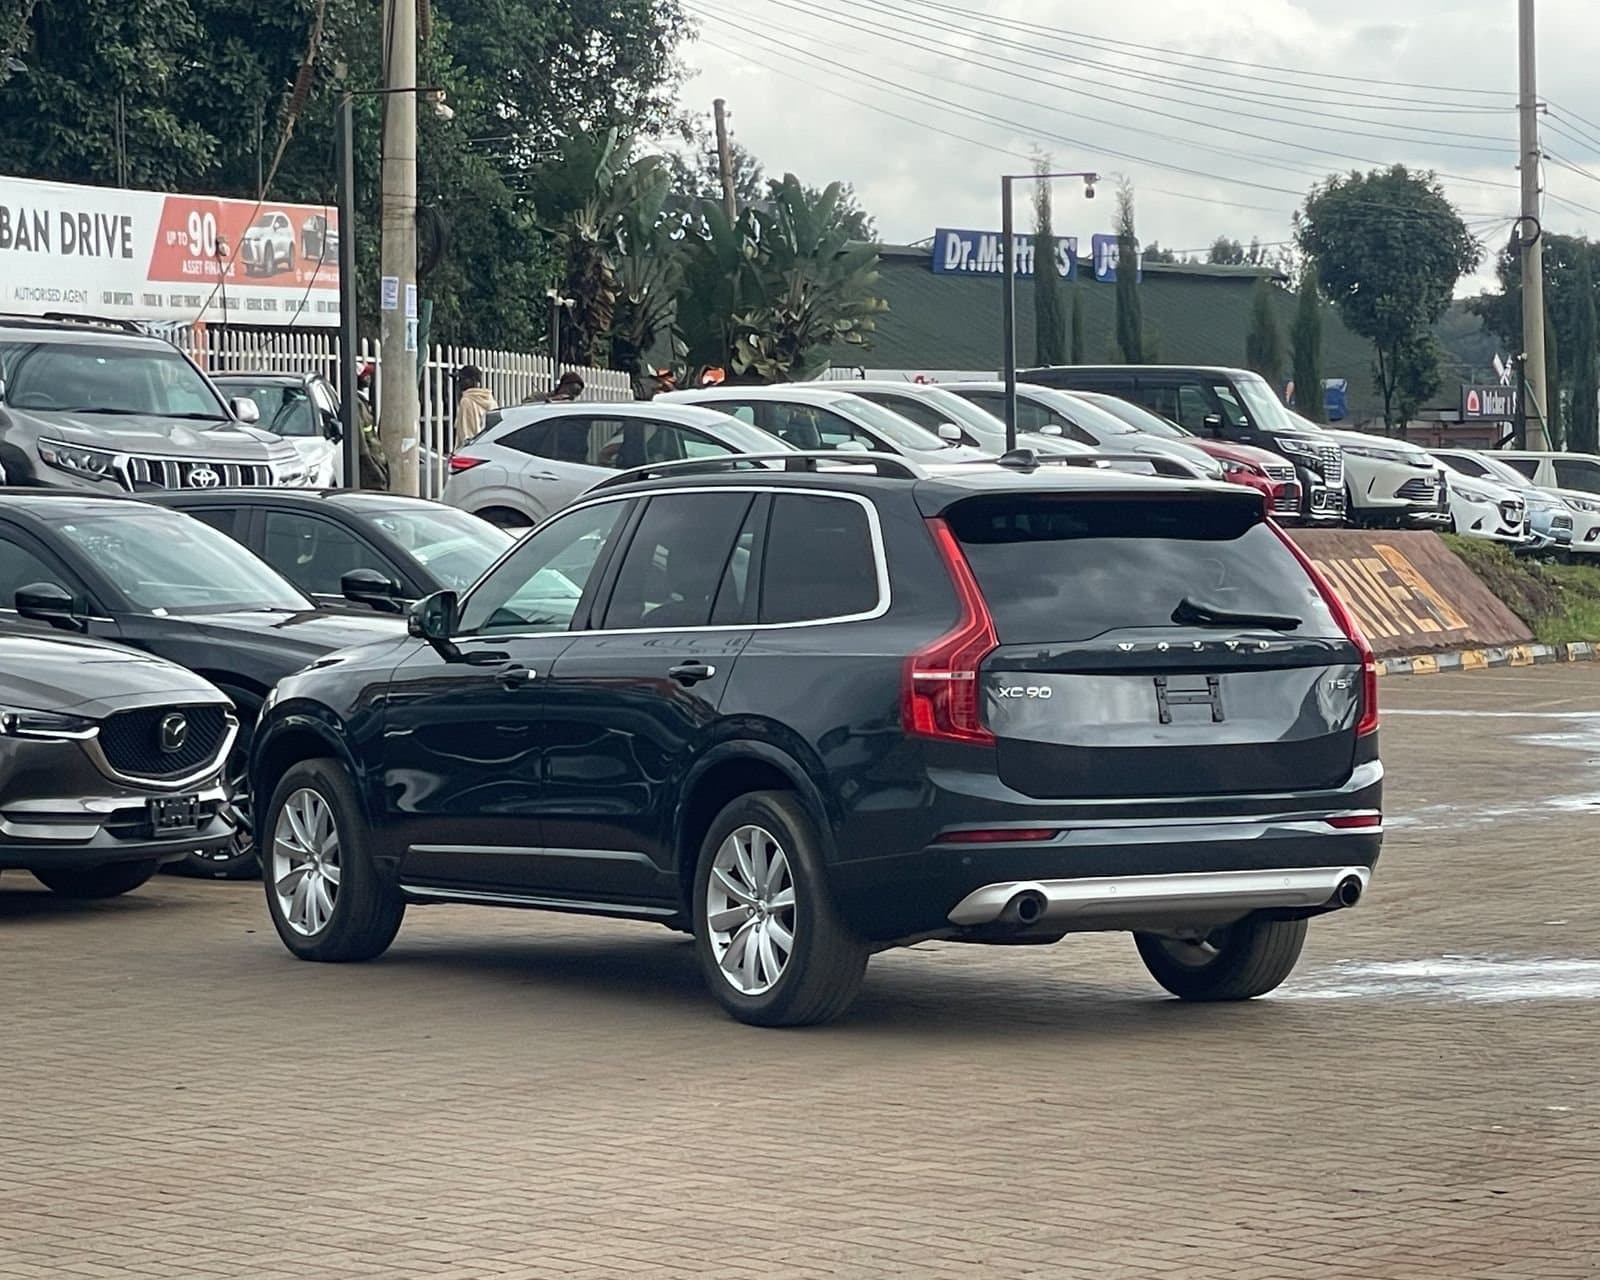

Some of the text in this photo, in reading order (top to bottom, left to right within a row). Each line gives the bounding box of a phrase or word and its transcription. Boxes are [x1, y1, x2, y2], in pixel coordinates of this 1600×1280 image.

[60, 211, 134, 259] DRIVE
[14, 287, 61, 302] AUTHORISED
[62, 289, 88, 304] AGENT
